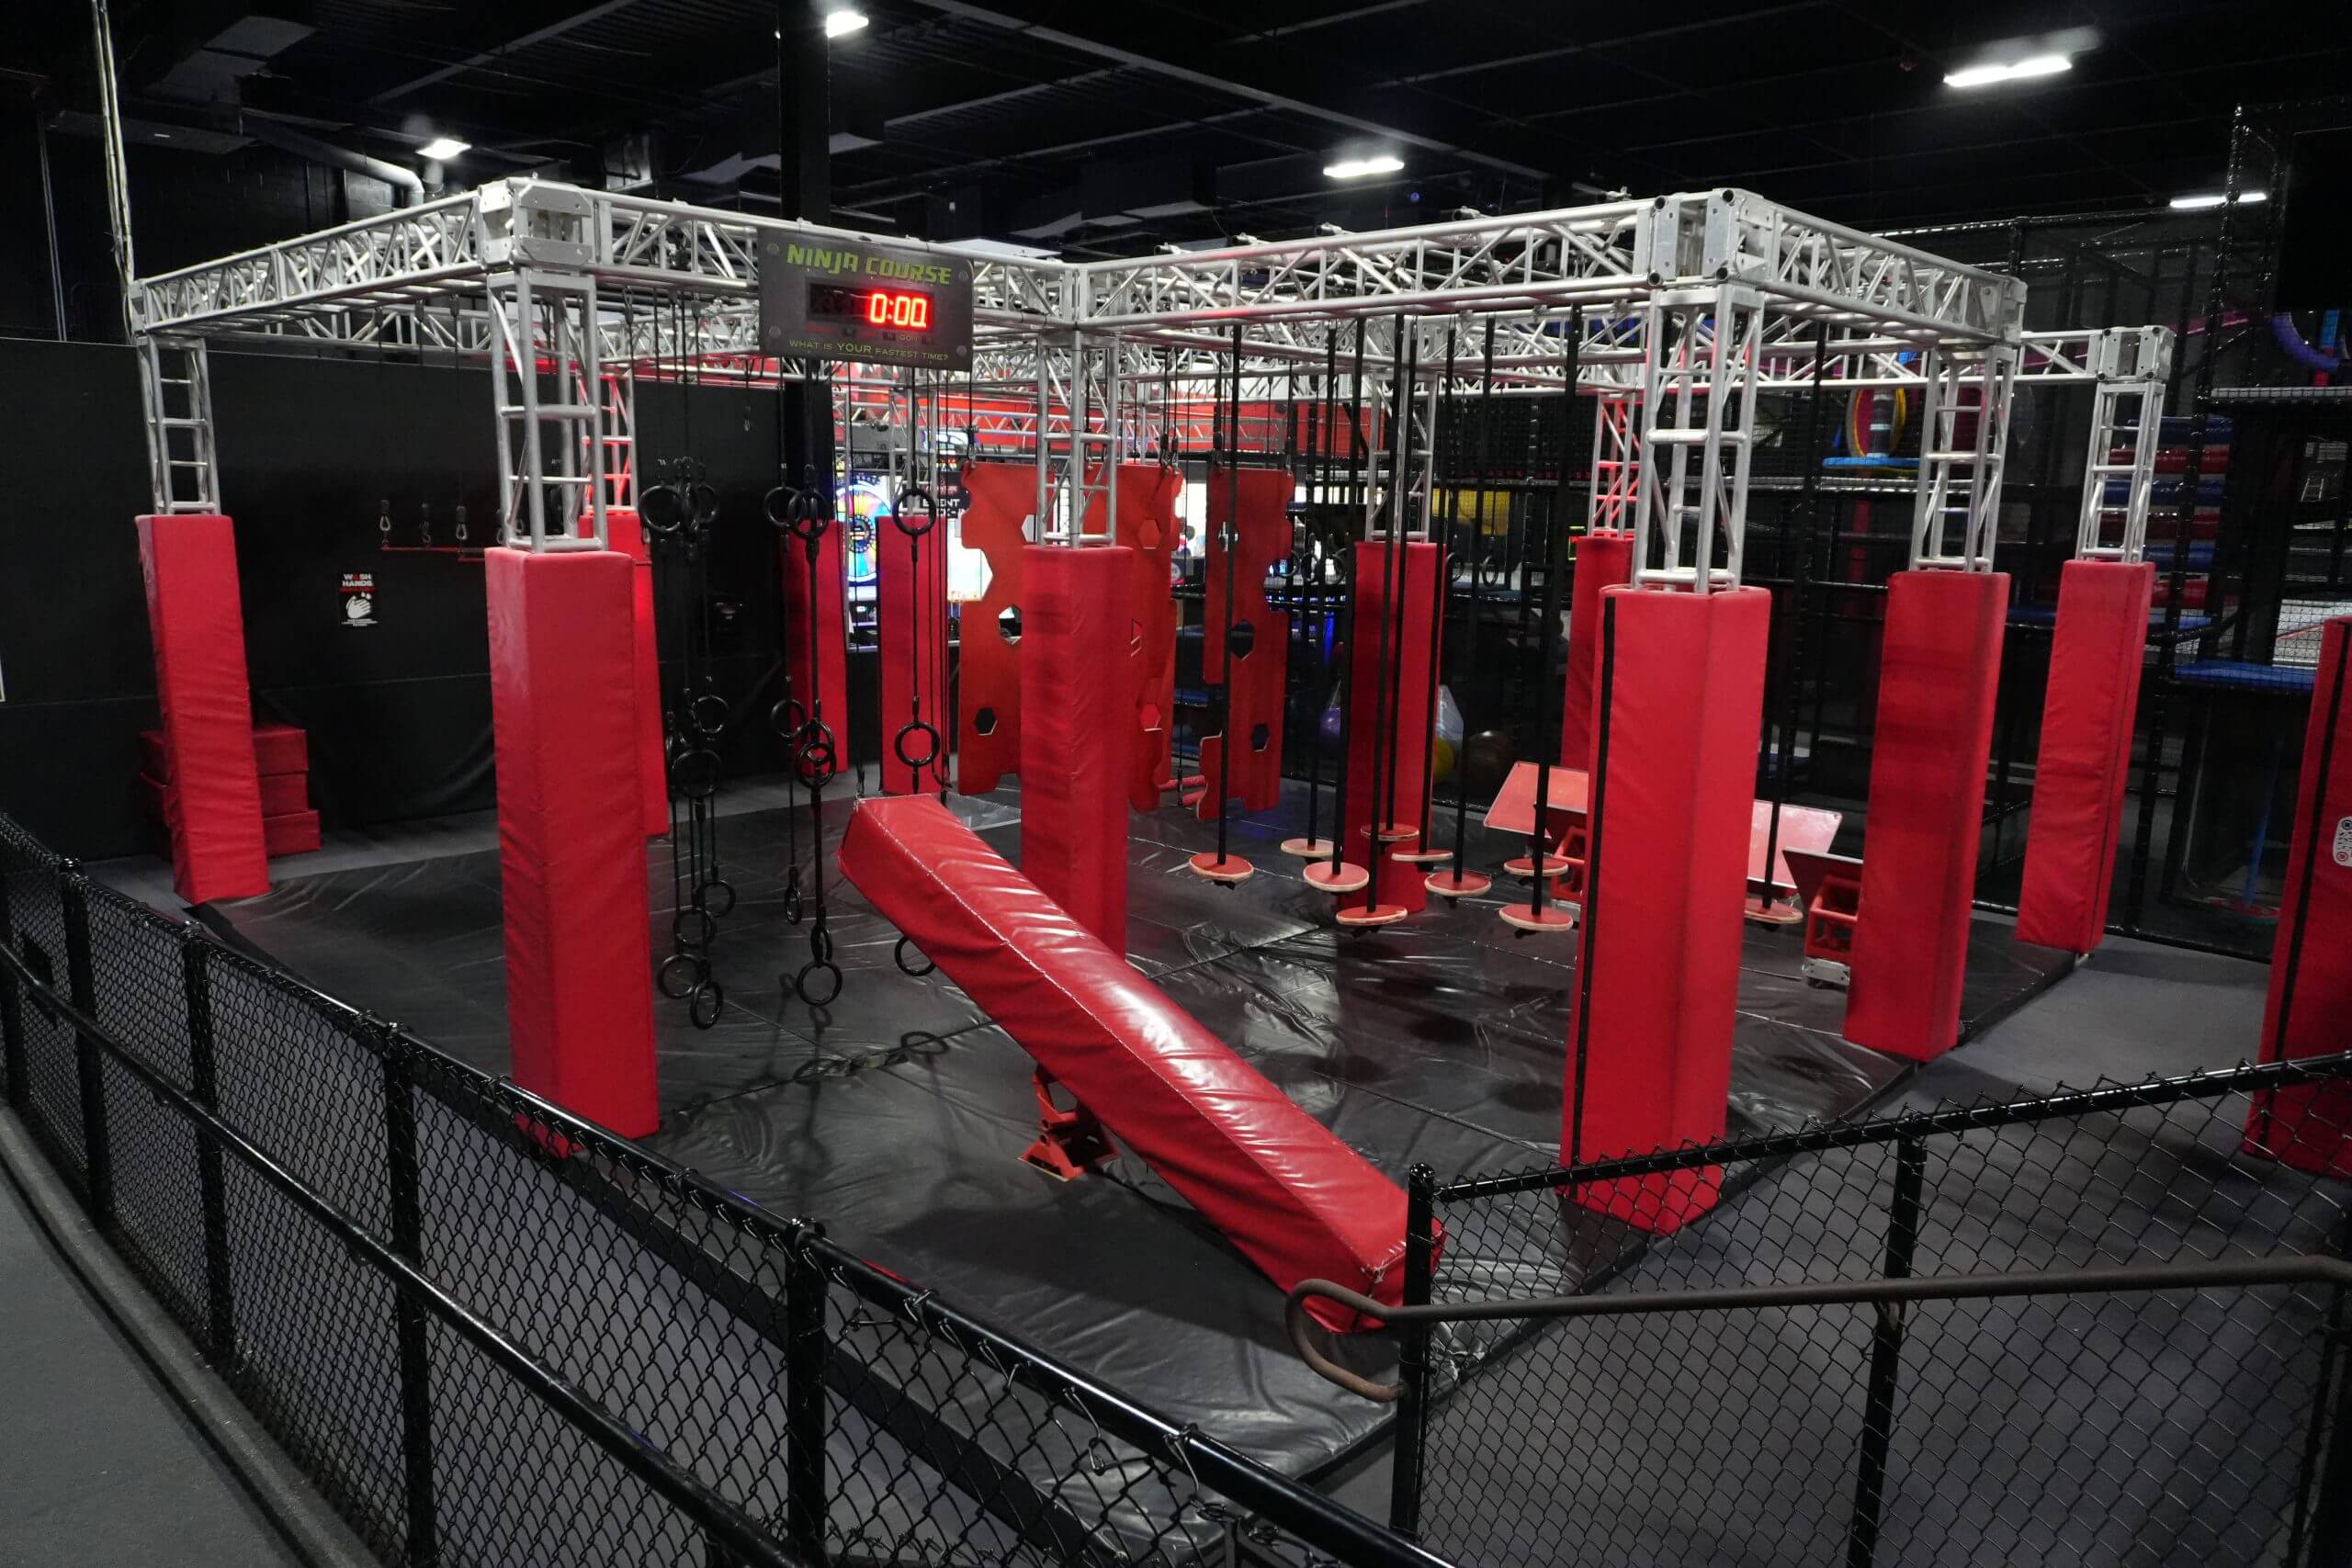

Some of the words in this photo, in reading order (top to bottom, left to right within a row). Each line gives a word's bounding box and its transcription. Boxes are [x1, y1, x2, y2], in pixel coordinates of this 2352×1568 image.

[786, 243, 859, 275] NINJA
[865, 256, 952, 285] COURSE
[869, 293, 927, 328] 0:00
[789, 339, 819, 349] WHAT
[837, 343, 872, 354] YOUR
[876, 347, 919, 358] FASTEST
[922, 352, 949, 361] TIME?
